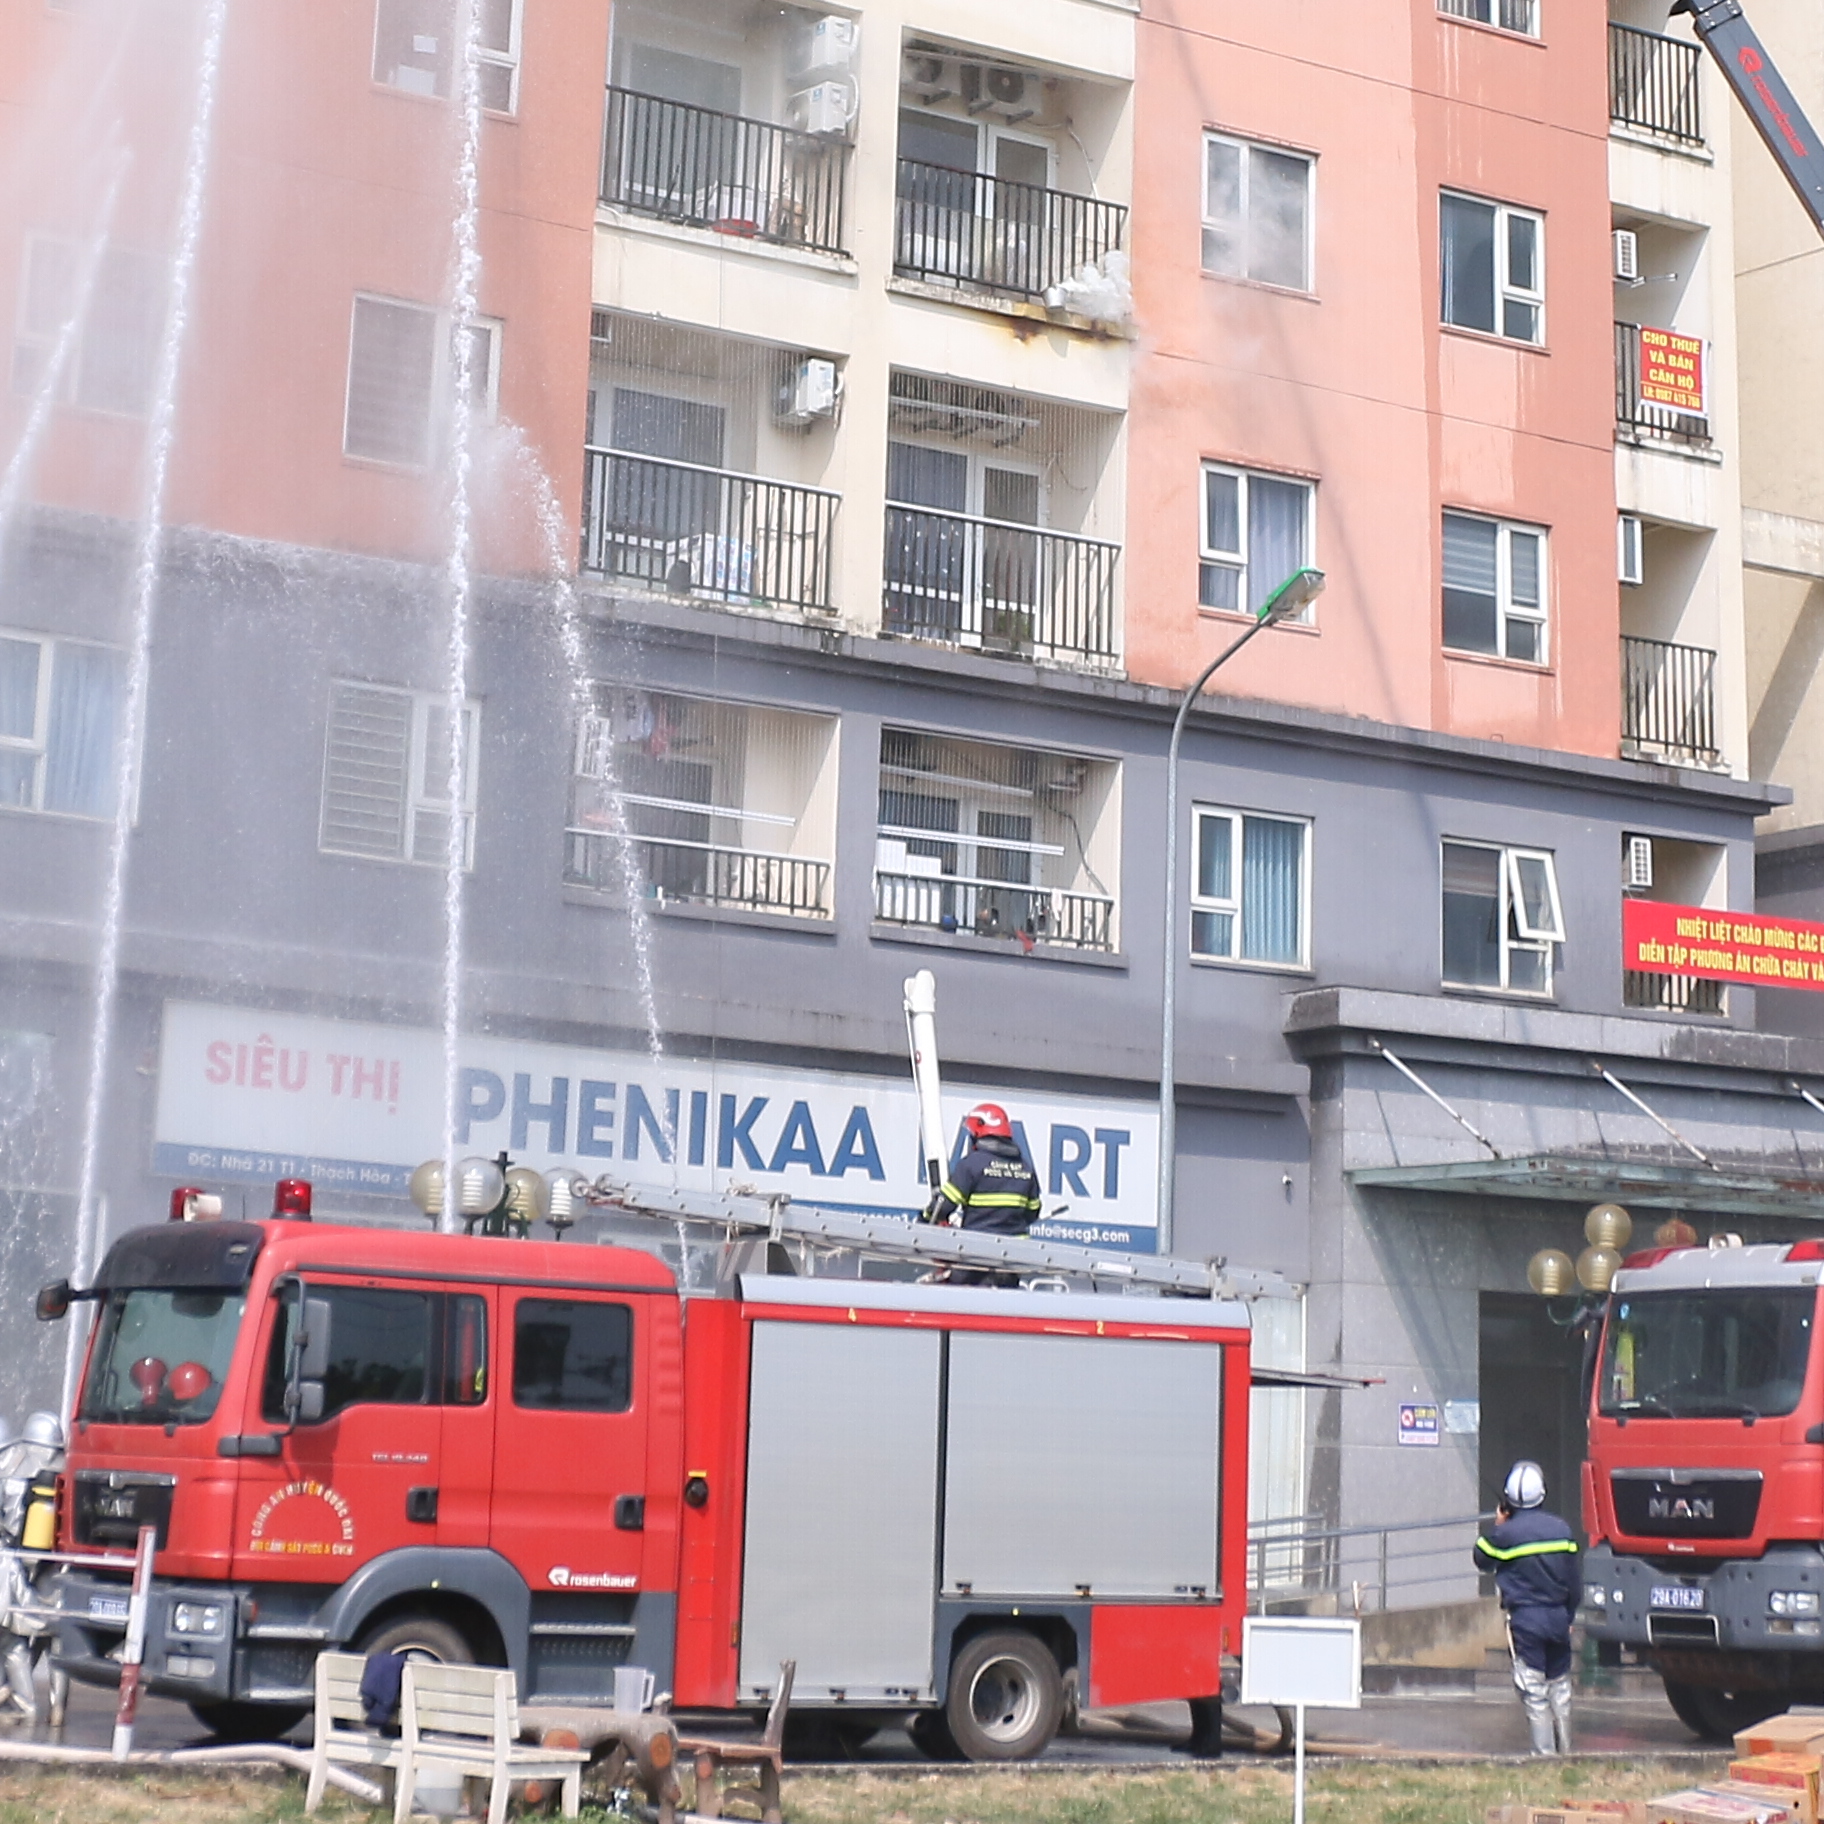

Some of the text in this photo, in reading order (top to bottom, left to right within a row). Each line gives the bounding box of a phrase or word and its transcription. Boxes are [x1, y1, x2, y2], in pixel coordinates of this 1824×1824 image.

[1642, 330, 1700, 355] CHO THUÊ
[1649, 349, 1694, 371] VÀ BÁN
[1649, 368, 1695, 391] CĂN HỘ
[1676, 916, 1708, 942] NHIỆT
[1709, 919, 1731, 945] LIỆT
[1733, 922, 1762, 946] CHÀO
[1764, 926, 1795, 950] MỪNG
[1797, 930, 1818, 953] CÁC
[1638, 938, 1665, 964] DIỄN
[1667, 943, 1688, 969] TẬP
[1690, 948, 1734, 971] PHƯƠNG
[1735, 950, 1751, 973] ÁN
[1753, 953, 1781, 977] CHỮA
[1782, 957, 1809, 980] CHÁY
[204, 1032, 402, 1115] SIÊU THỊ
[454, 1066, 1131, 1201] PHENIKAA RT
[257, 1158, 273, 1173] 21
[847, 1307, 858, 1322] 4
[1096, 1320, 1105, 1335] 2
[1649, 1498, 1714, 1519] MAN
[569, 1573, 637, 1588] rosenbauer
